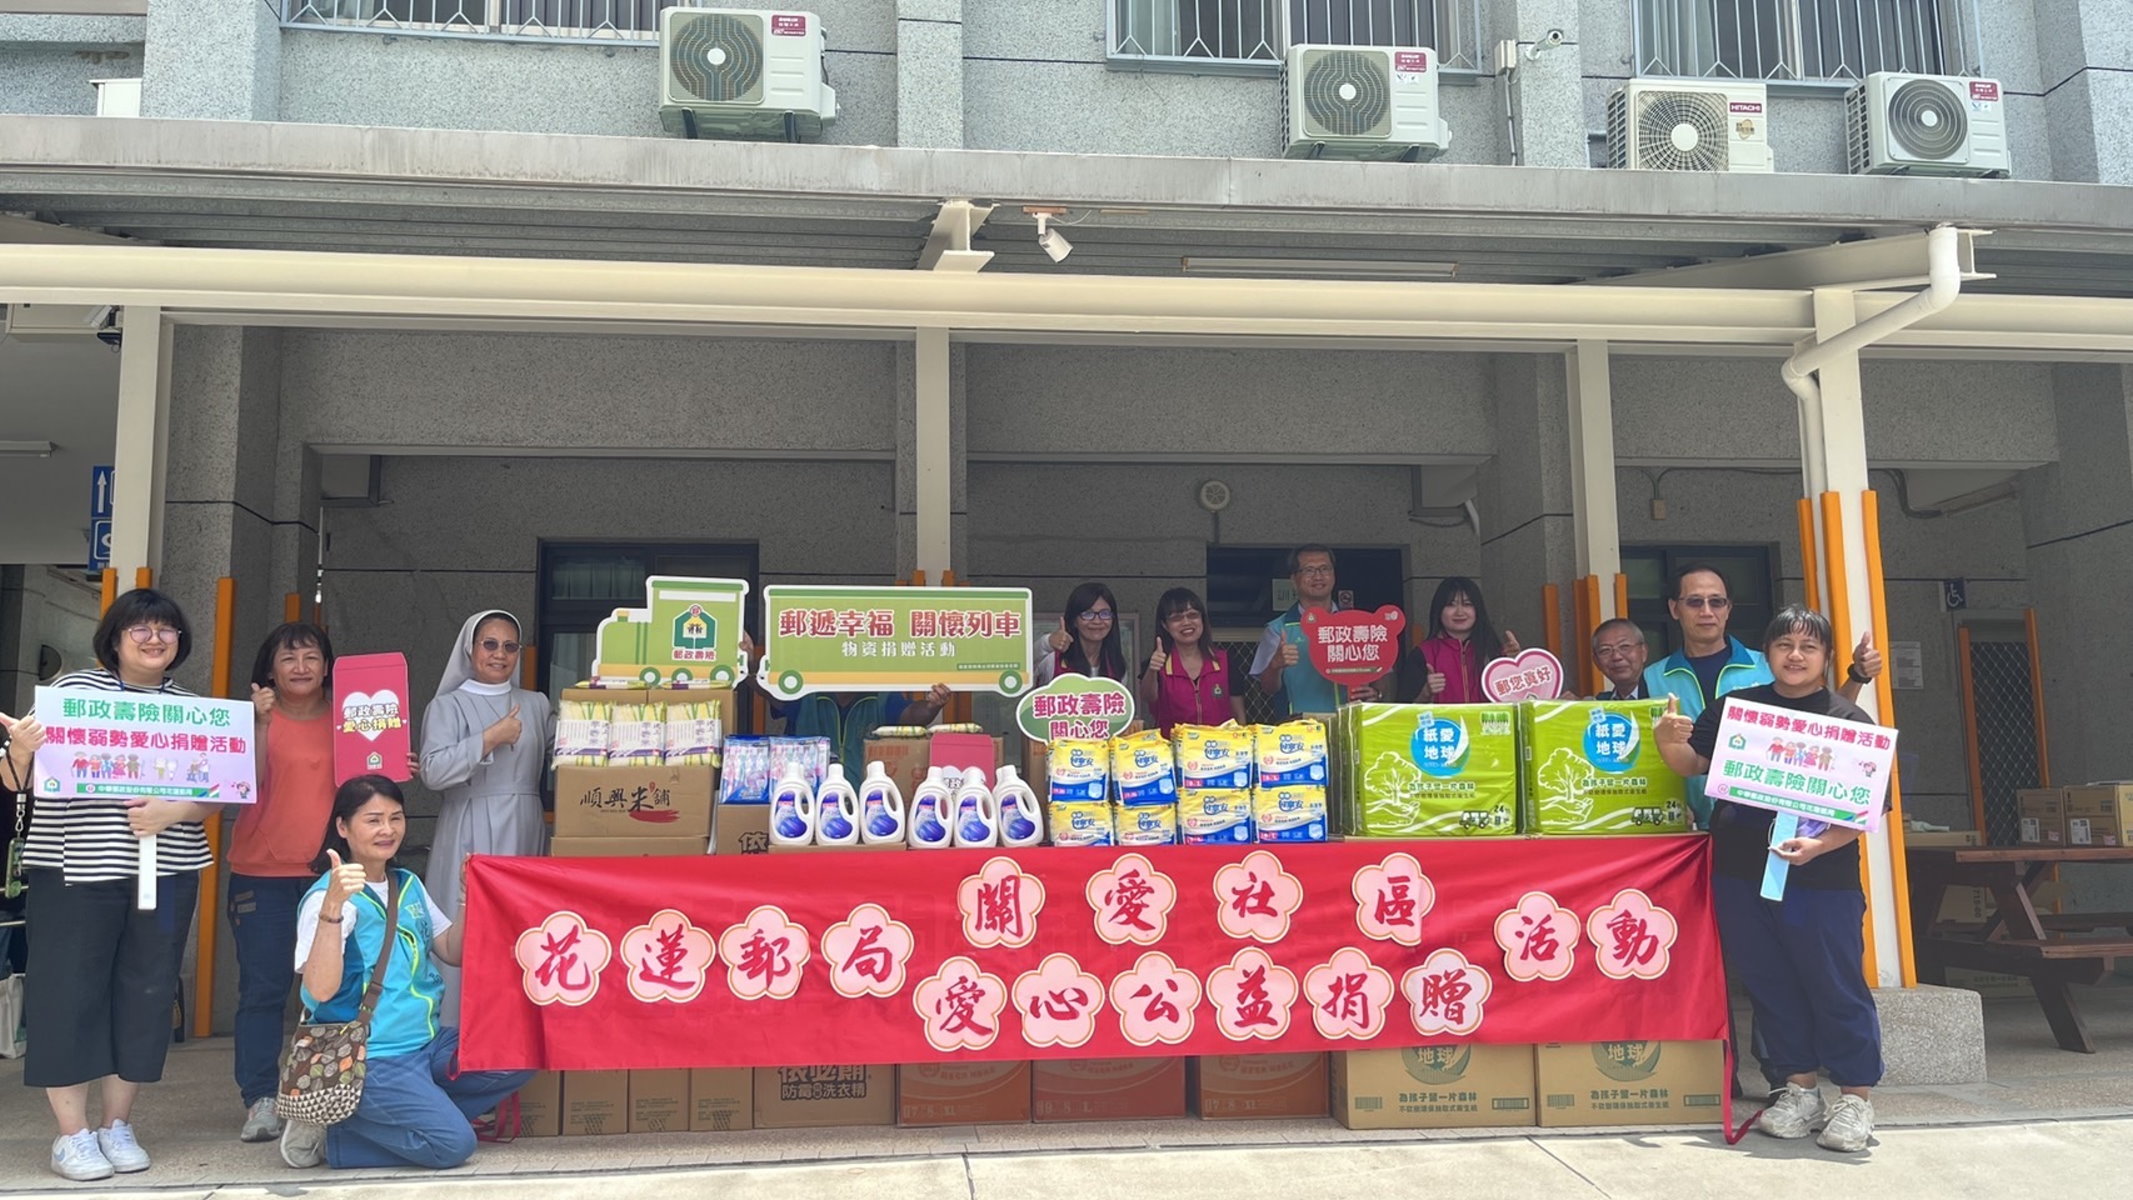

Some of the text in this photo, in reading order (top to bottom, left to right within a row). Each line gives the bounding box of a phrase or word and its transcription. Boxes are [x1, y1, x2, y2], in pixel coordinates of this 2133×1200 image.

[779, 608, 1021, 638] 郵遞幸福 關懷列車
[1318, 625, 1388, 644] 郵政壽險
[673, 650, 716, 660] 郵政壽險
[842, 641, 956, 657] 物資捐贈活動
[1327, 644, 1380, 662] 關心您
[63, 697, 231, 727] 郵政壽險關心您
[1034, 693, 1126, 717] 郵政壽險
[343, 717, 402, 733] 愛心捐贈
[1050, 719, 1109, 740] 關心您
[1423, 728, 1455, 742] 紙愛
[1595, 723, 1626, 738] 紙愛
[1727, 706, 1891, 751] 關懷弱勢愛心捐贈活動
[45, 726, 247, 754] 關懷弱勢愛心捐贈活動
[1596, 741, 1626, 755] 地球
[1424, 745, 1455, 760] 地球
[1723, 759, 1872, 806] 郵政壽險關心您
[975, 868, 1416, 939] 關愛社區
[1515, 909, 1660, 968] 活動
[534, 923, 894, 992] 花蓮郵局
[934, 966, 1474, 1036] 愛心公益捐贈
[1418, 1047, 1454, 1064] 地球
[1608, 1044, 1644, 1061] 地球
